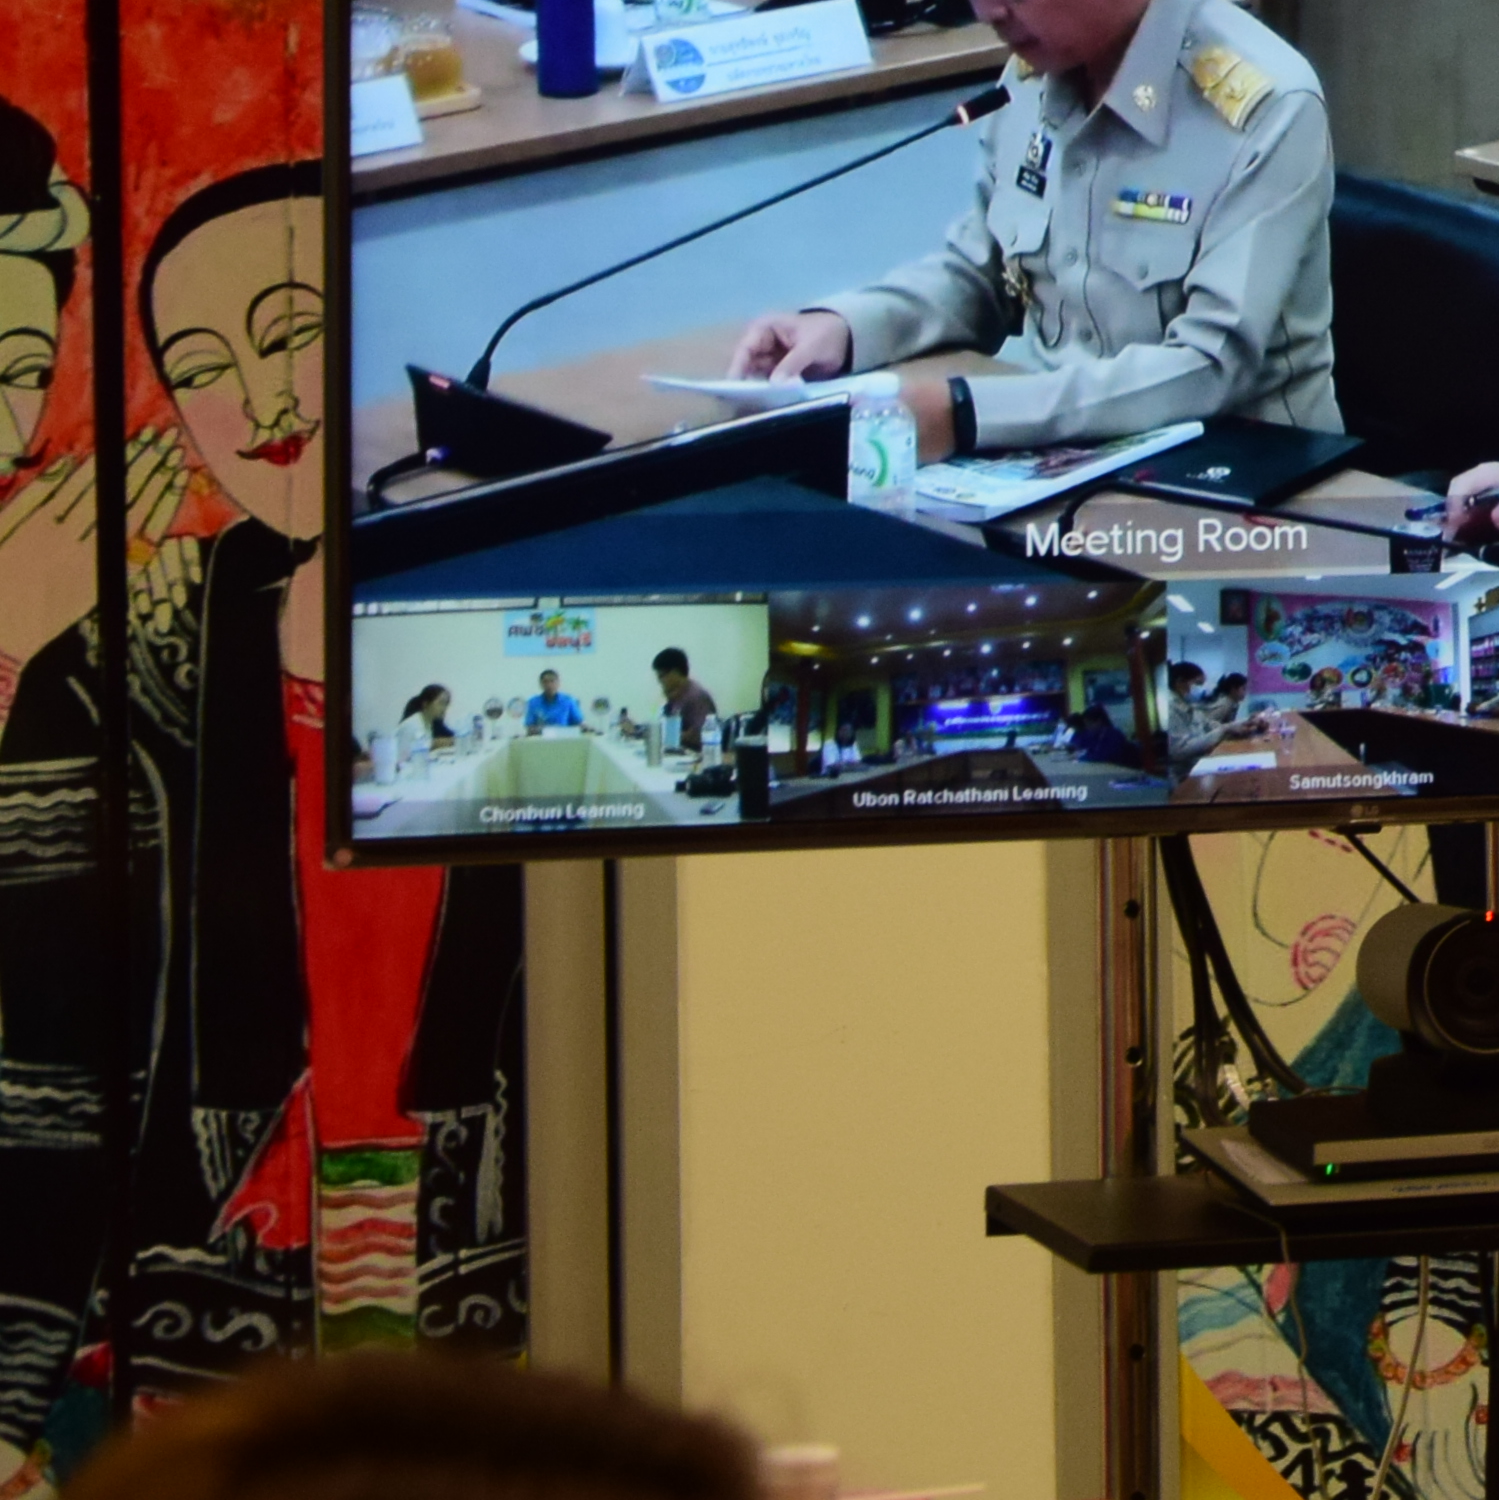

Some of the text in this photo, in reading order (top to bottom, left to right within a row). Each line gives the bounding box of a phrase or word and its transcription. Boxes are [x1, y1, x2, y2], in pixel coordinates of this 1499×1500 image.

[1025, 518, 1308, 562] Meeting Room
[1289, 769, 1435, 791] Samutsongkhram
[852, 782, 1089, 808] Ubon Ratchathani Learning
[480, 800, 645, 823] Chonburi Learning
